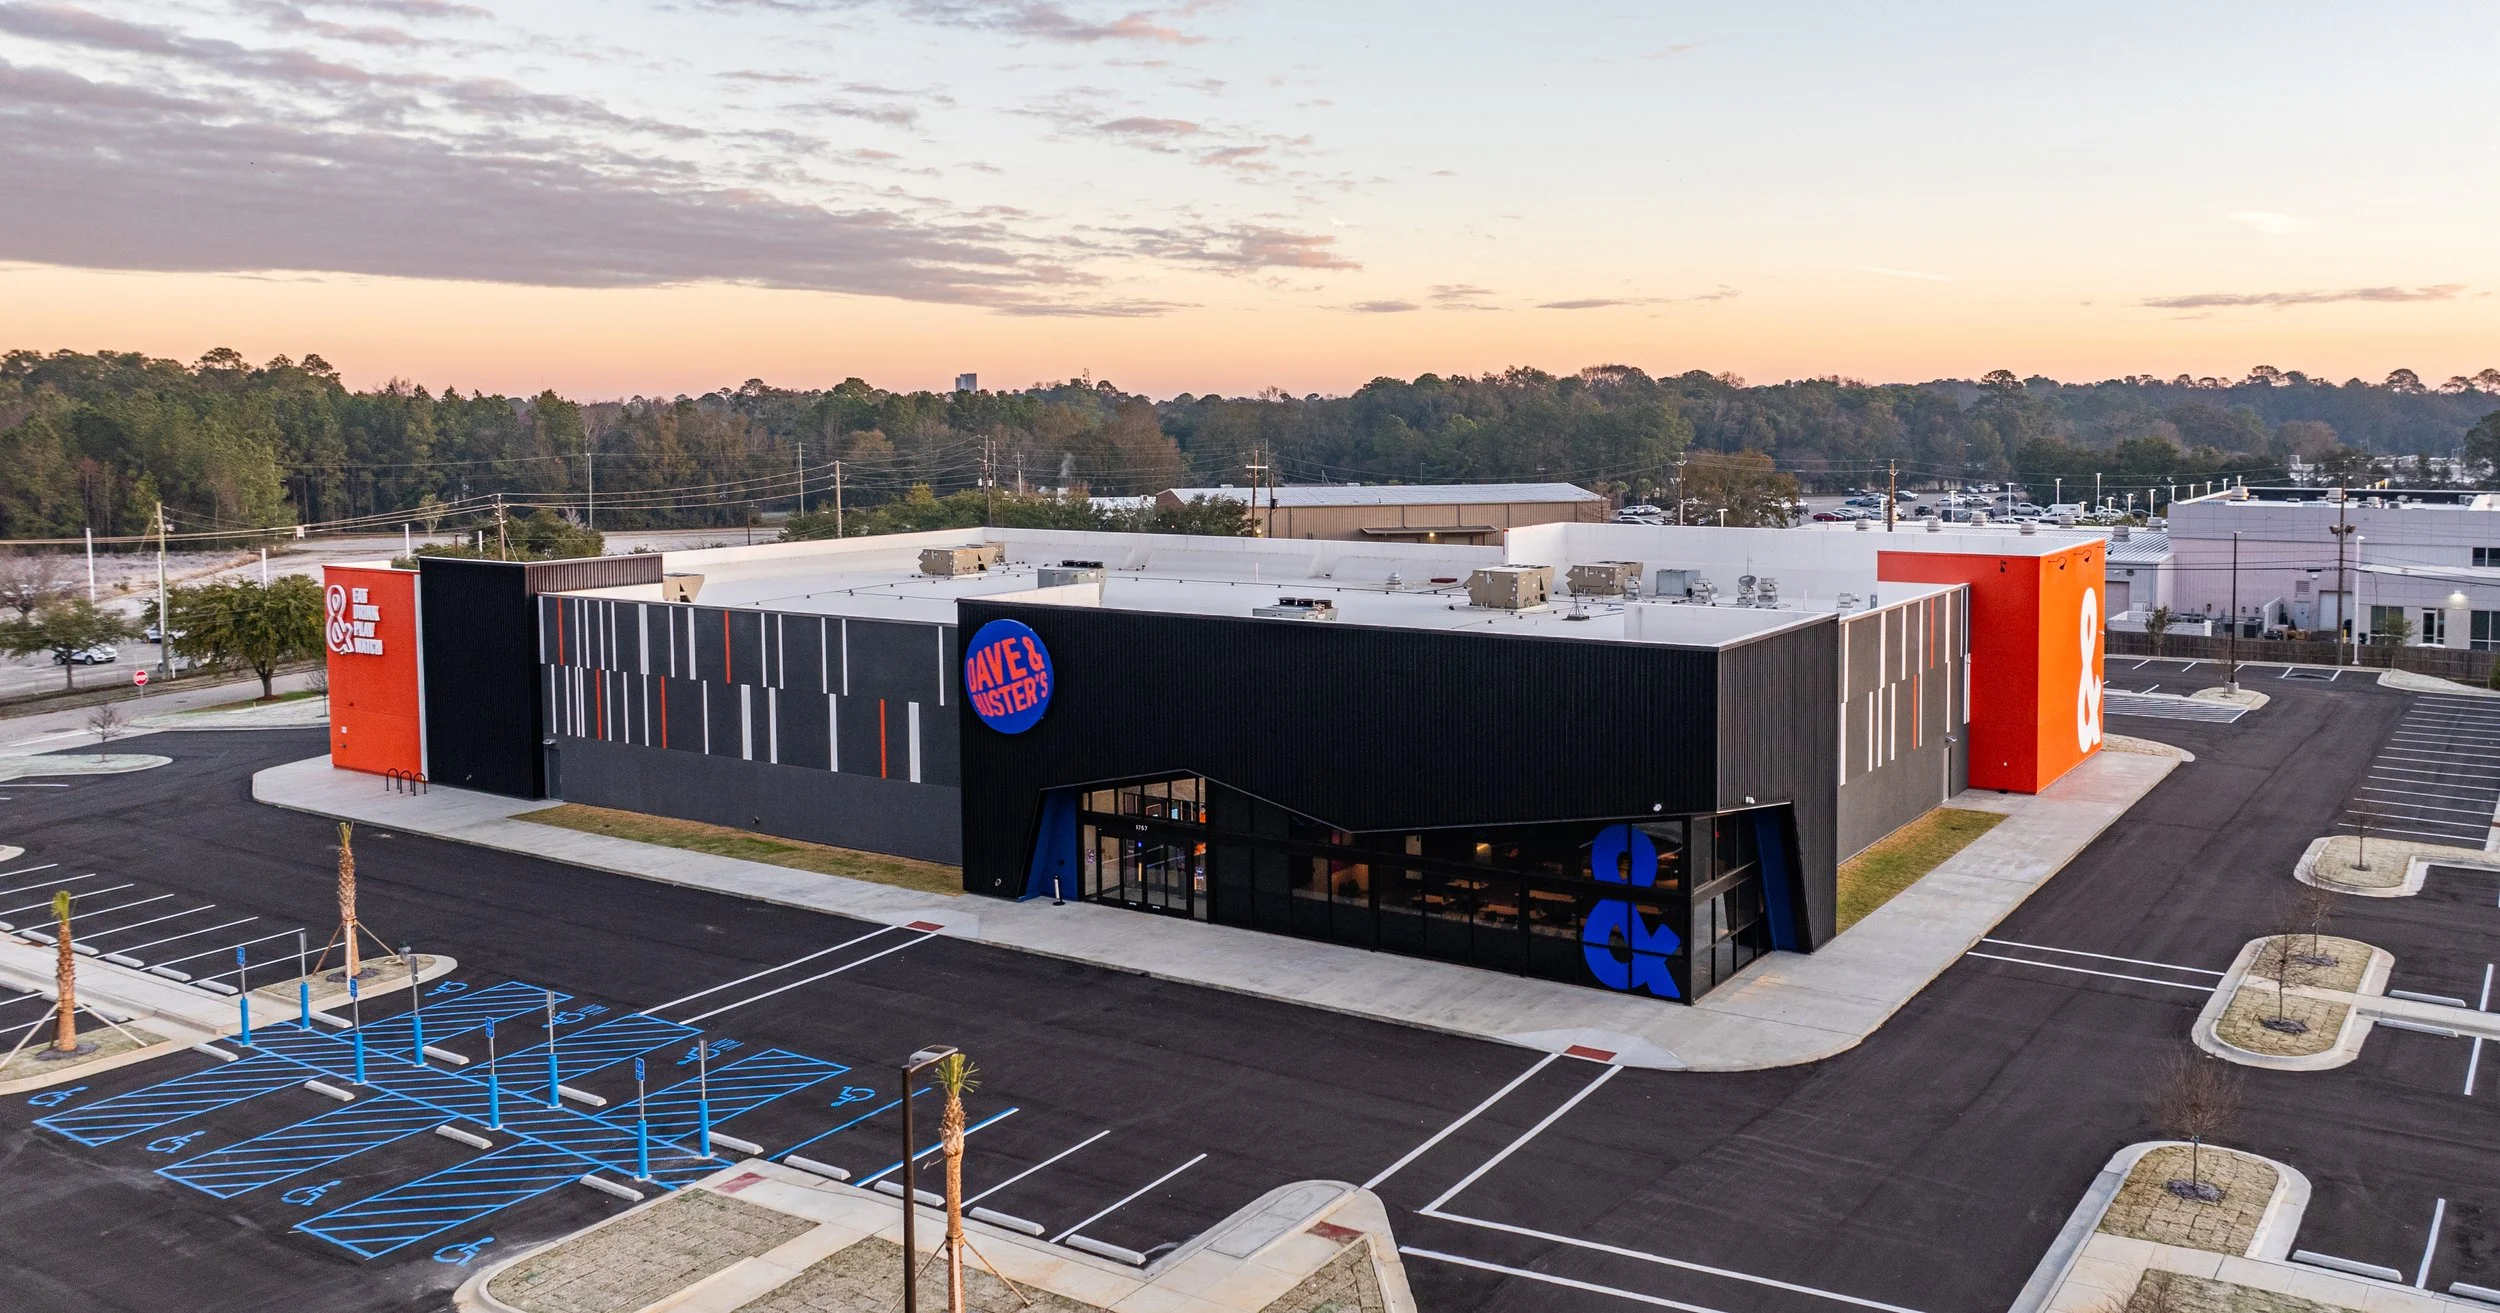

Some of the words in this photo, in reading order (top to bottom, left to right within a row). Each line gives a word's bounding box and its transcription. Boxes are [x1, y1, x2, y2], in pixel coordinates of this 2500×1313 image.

[327, 585, 355, 654] &
[352, 588, 368, 603] EAT
[354, 621, 375, 637] PLAY
[967, 637, 1028, 693] DAVE
[1022, 636, 1045, 671] &
[2077, 587, 2102, 753] &
[972, 671, 1048, 717] BUSTER'S
